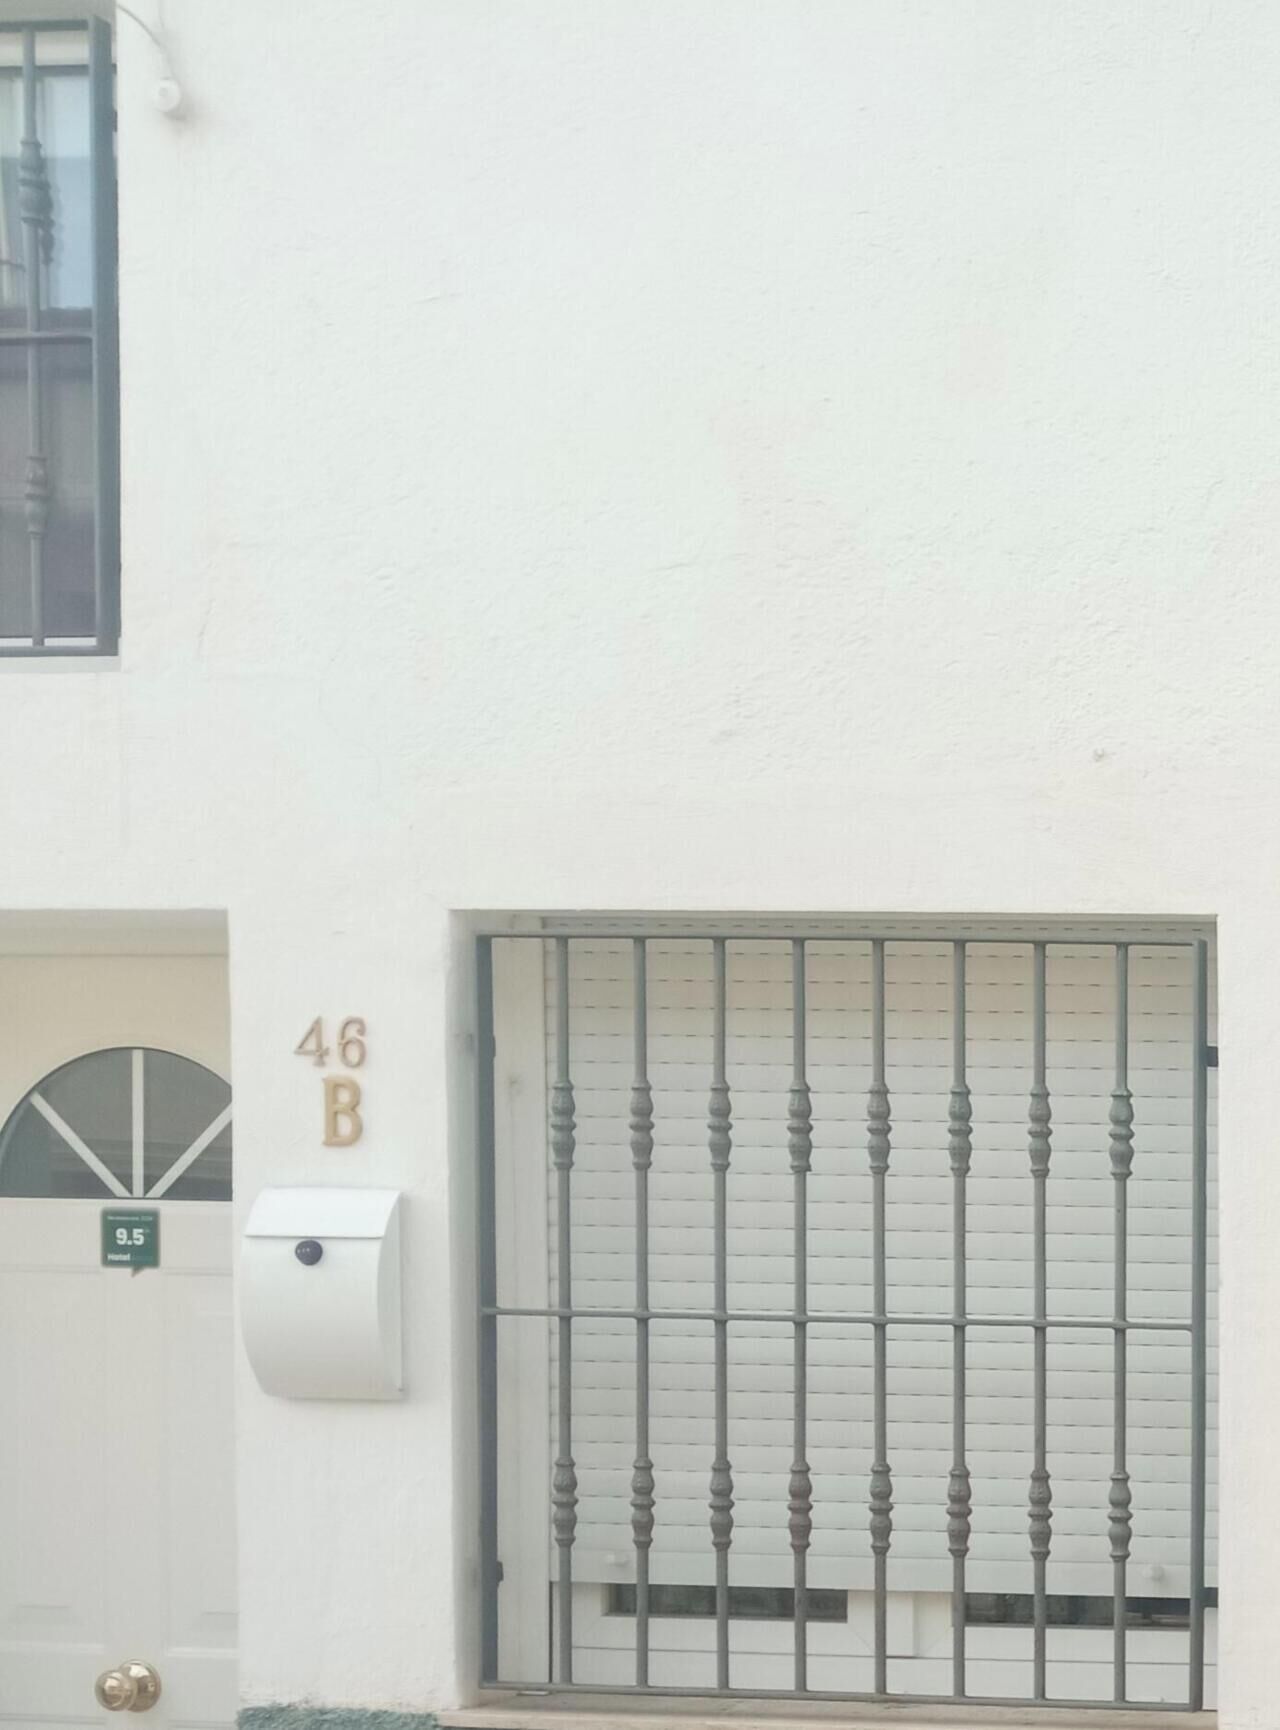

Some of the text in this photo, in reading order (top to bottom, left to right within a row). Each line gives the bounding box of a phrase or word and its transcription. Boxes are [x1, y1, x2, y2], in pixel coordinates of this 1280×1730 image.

[294, 1015, 368, 1069] 46
[322, 1074, 364, 1148] B
[115, 1227, 145, 1246] 9.5
